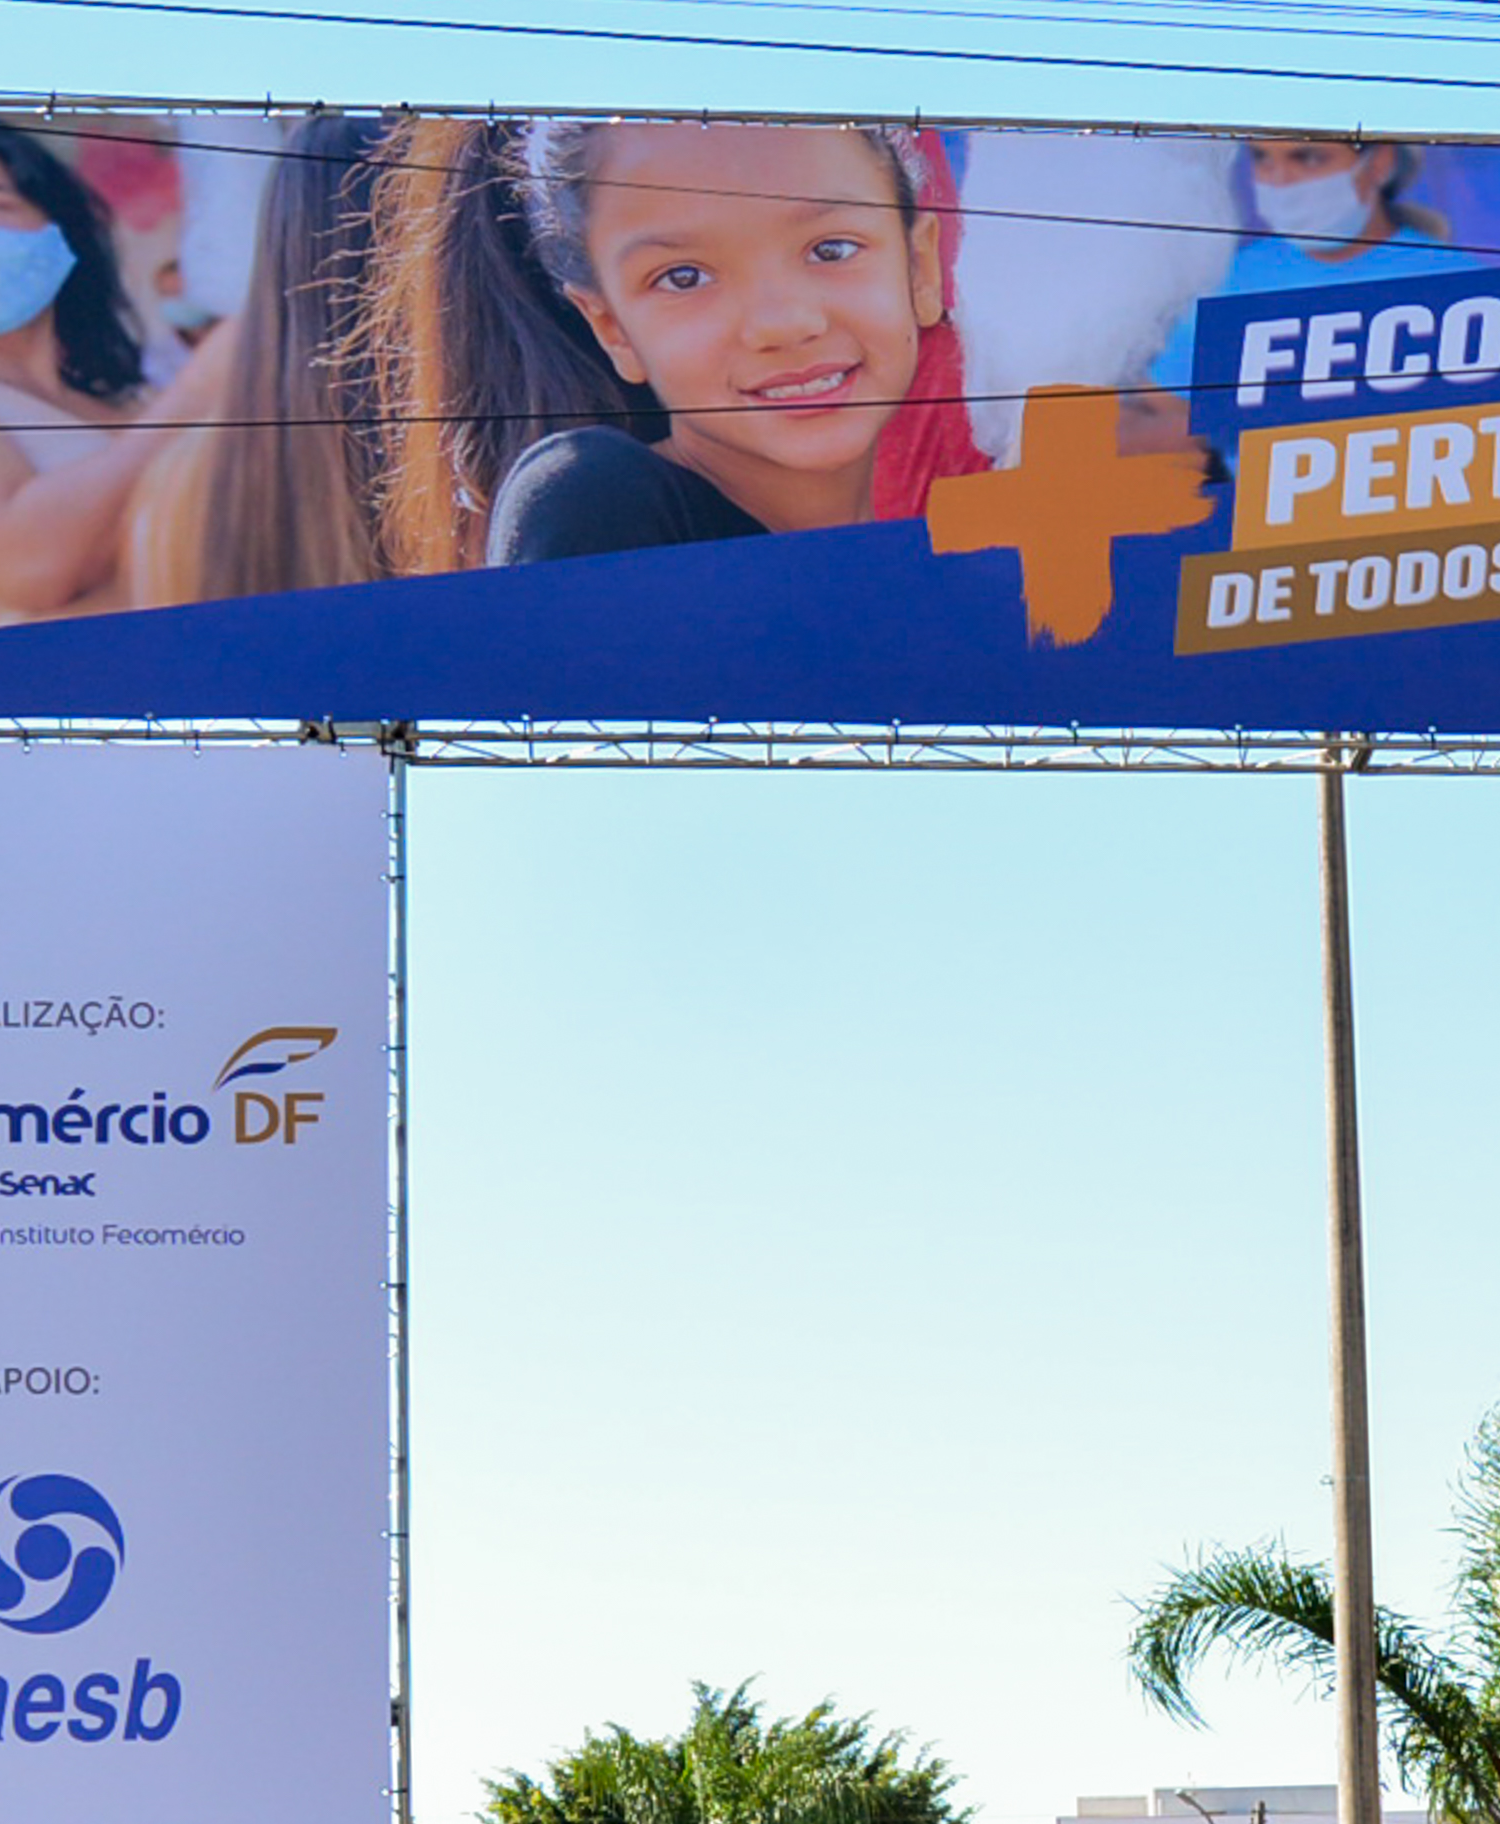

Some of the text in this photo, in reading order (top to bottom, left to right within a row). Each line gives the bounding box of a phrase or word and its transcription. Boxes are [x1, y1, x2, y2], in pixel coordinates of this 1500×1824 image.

[1205, 562, 1294, 630] DE
[233, 1091, 326, 1145] DF
[102, 1224, 247, 1248] Fecomércio
